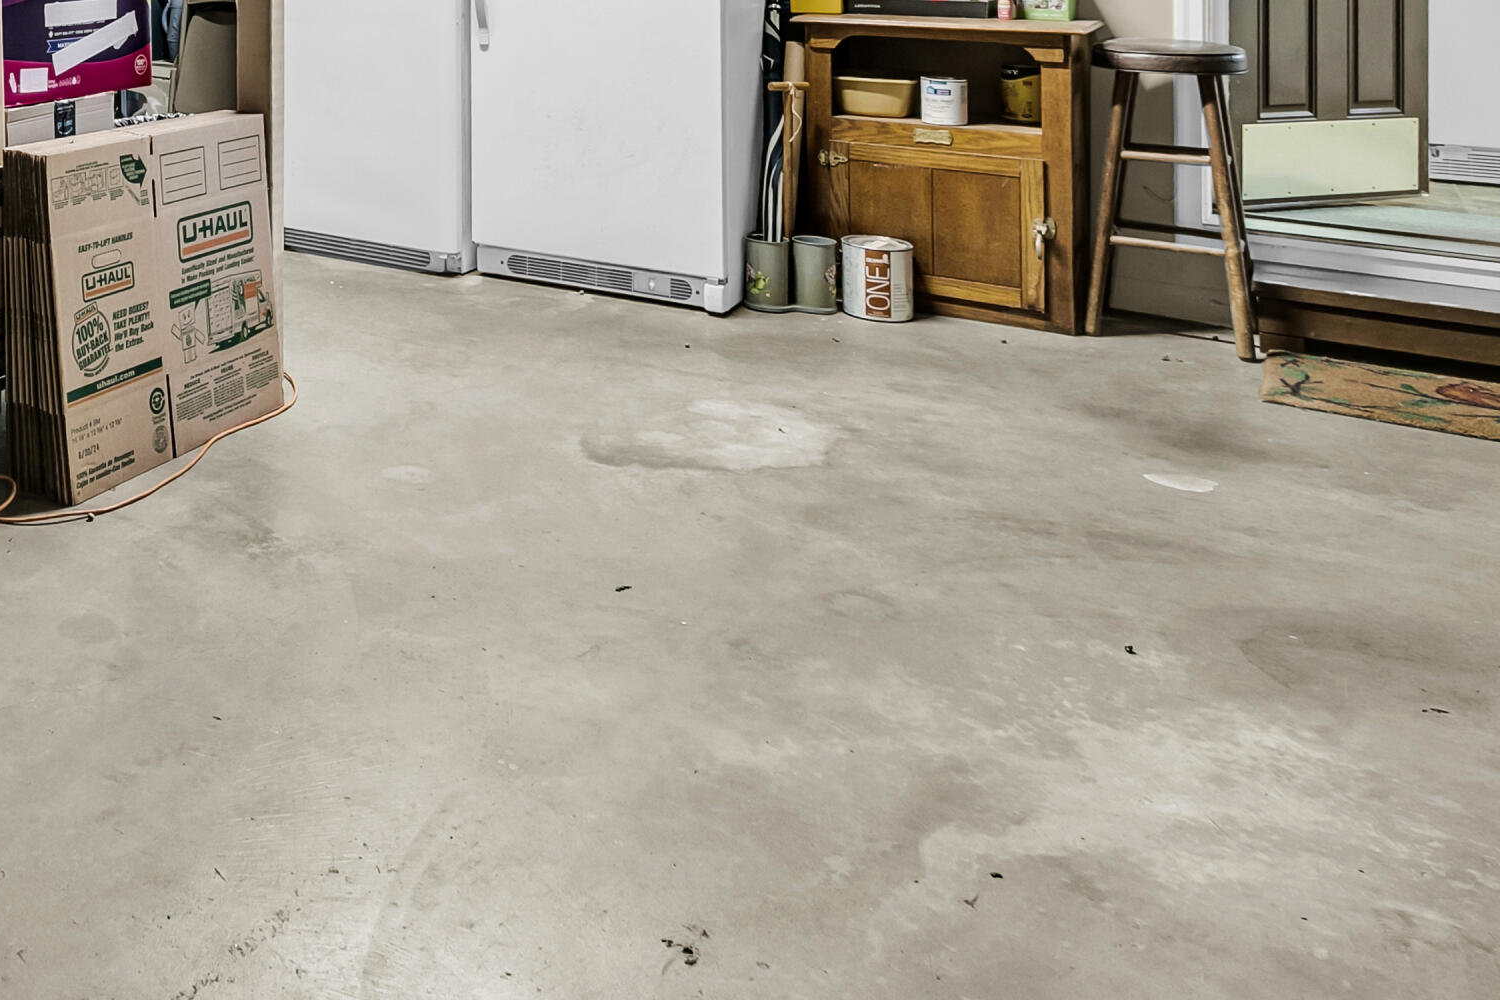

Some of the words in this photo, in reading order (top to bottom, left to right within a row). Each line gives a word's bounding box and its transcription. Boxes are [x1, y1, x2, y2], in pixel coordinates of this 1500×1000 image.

[182, 209, 248, 244] U-HAUL
[78, 237, 111, 254] EASY-TO-LIFT
[111, 231, 133, 245] HANDLES
[85, 266, 131, 291] U-HAUL
[865, 265, 891, 311] ONE
[75, 304, 97, 320] U-HAUL
[112, 308, 128, 320] NEED
[128, 301, 149, 315] BOXES?
[113, 320, 127, 331] TAKE
[128, 311, 150, 326] PLENTY!
[75, 316, 104, 345] 100%
[129, 327, 139, 337] Buy
[140, 321, 154, 333] Back
[76, 330, 109, 360] BUY-BACK
[114, 343, 125, 353] the
[125, 336, 145, 349] Extras.
[78, 343, 111, 372] GUARANTEE
[96, 369, 136, 390] uhaul.com
[183, 377, 201, 390] REDUCE
[70, 423, 89, 435] Product
